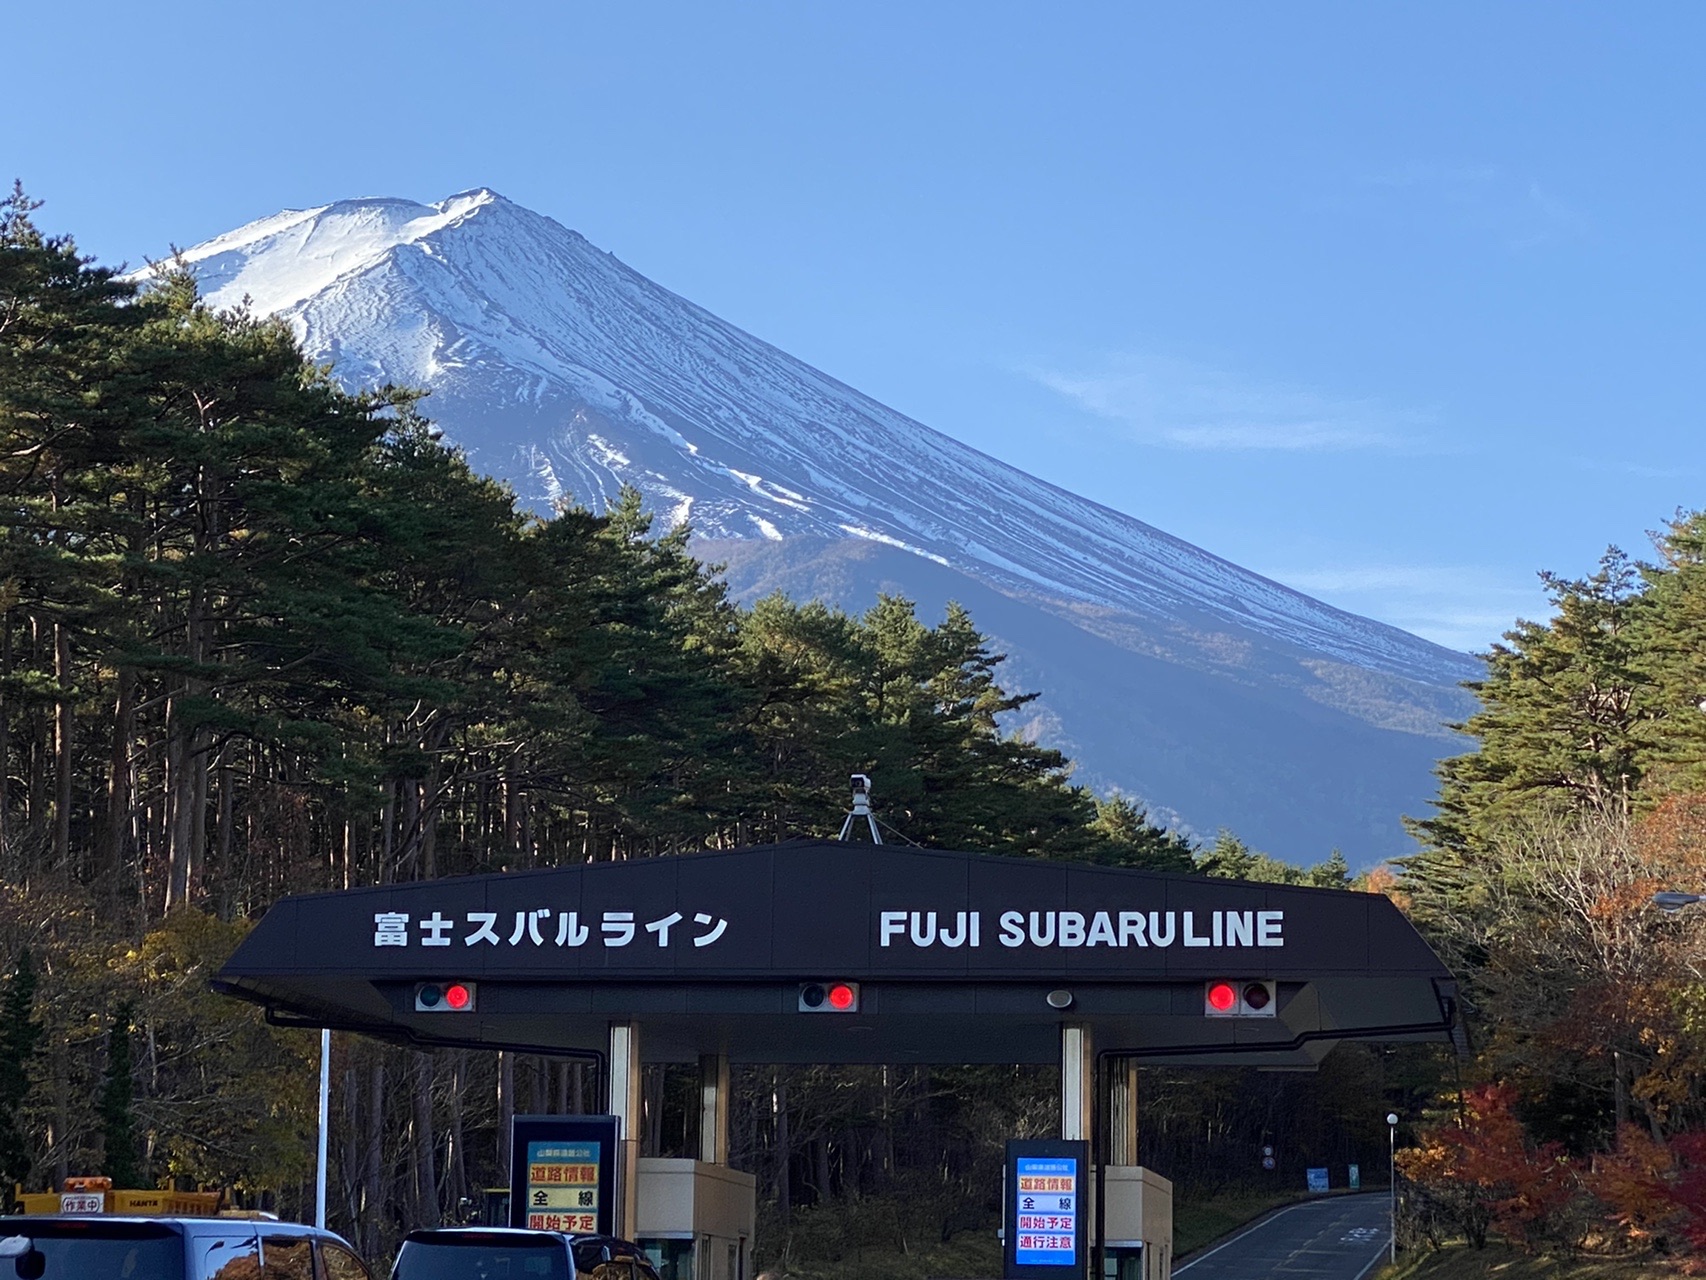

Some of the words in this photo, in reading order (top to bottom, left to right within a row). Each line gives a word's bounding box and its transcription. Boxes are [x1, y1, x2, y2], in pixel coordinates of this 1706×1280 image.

[374, 908, 728, 947] 富士スバルライン
[880, 911, 980, 947] FUJI
[531, 1167, 594, 1181] 道路情報
[1020, 1178, 1072, 1190] 道路情報
[529, 1215, 594, 1230] 開始予定
[1020, 1217, 1072, 1229] 開始予定
[1020, 1236, 1072, 1249] 通行注意
